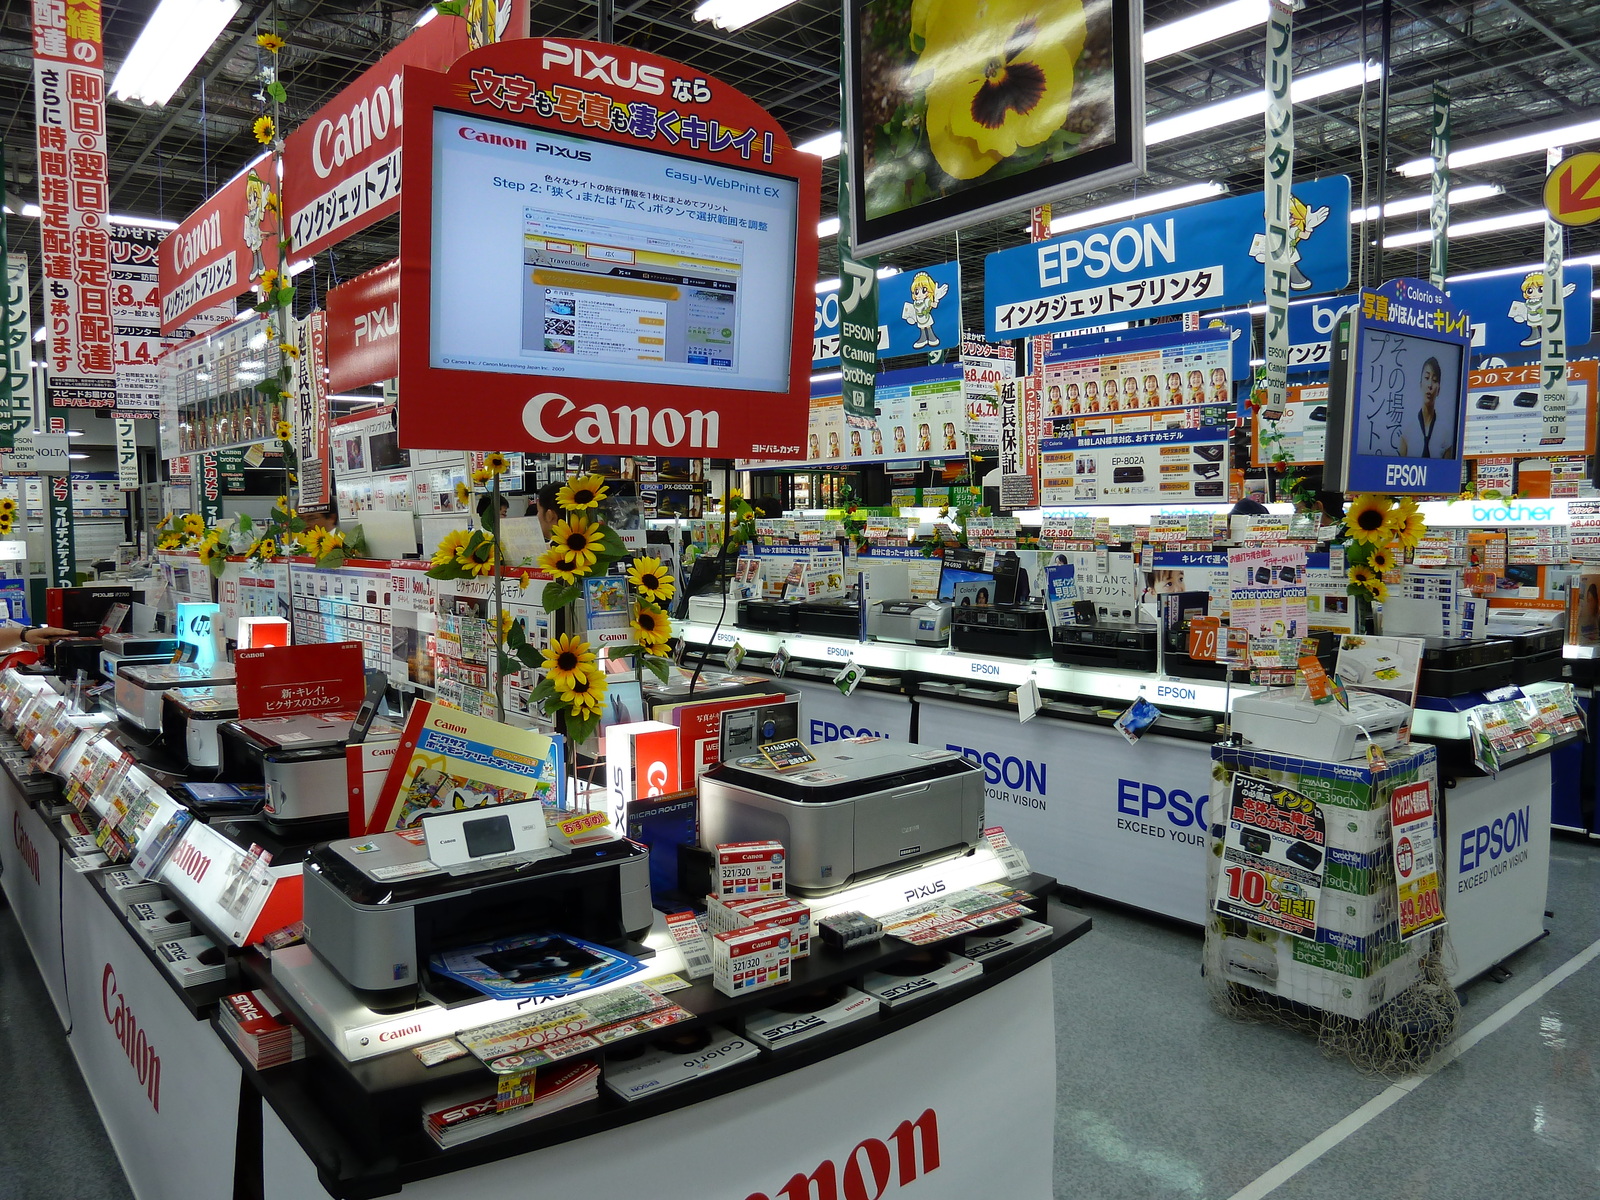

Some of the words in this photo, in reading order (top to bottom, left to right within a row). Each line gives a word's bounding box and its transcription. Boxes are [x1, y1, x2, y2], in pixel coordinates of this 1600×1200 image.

[542, 41, 664, 96] PIXUS
[672, 77, 711, 103] なら
[470, 67, 774, 165] 文字も写真も凄くキレイ！
[458, 127, 527, 150] Canon
[536, 143, 592, 162] PIXUS
[493, 177, 526, 192] Step
[530, 183, 542, 193] 2:
[665, 168, 761, 195] Easy-WebPrint
[764, 187, 780, 198] EX
[1268, 20, 1291, 340] プリンターフェア
[173, 209, 222, 275] Canon
[549, 257, 590, 268] TravelGuide
[1037, 218, 1176, 289] EPSON
[164, 257, 232, 321] インクジェットプリンタ
[1407, 286, 1433, 304] Colorio
[1000, 271, 1213, 330] インクジェットプリンタ
[354, 303, 399, 347] PIXU
[1361, 292, 1470, 338] 写真がほんとにキレイ！
[842, 322, 875, 342] EPSON
[842, 344, 875, 364] Canon
[963, 341, 1015, 359] プリンター設定
[1268, 346, 1287, 359] EPSON
[841, 366, 875, 386] brother
[1544, 394, 1565, 402] EPSON
[522, 392, 720, 448] Canon
[1001, 381, 1018, 475] 延長保証
[1025, 378, 1036, 469] 買った後も安心！
[752, 444, 800, 454] ヨドバシカメラ
[1111, 457, 1145, 466] EP-802A
[1385, 464, 1427, 487] EPSON
[1472, 504, 1555, 522] brother
[1044, 528, 1073, 537] ¥22,980
[1077, 573, 1132, 585] 無線LANで、
[1231, 588, 1256, 600] brother
[1257, 588, 1281, 599] brother
[1282, 586, 1306, 597] brother
[599, 633, 628, 643] Canon
[717, 633, 735, 642] EPSON
[240, 651, 265, 659] Canon
[827, 646, 850, 657] EPSON
[971, 662, 1000, 675] EPSON
[1157, 685, 1196, 700] EPSON
[265, 695, 340, 711] ピクサスのひみつ
[433, 718, 468, 735] Canon
[428, 732, 467, 750] ピクサス
[425, 741, 536, 775] ポケモンプリントギャラリー
[1333, 766, 1363, 779] brother
[1236, 778, 1273, 792] プリンター
[984, 787, 1010, 803] YOUR
[1012, 793, 1047, 811] VISION
[1272, 789, 1316, 814] インク
[629, 808, 657, 820] MICRO
[658, 800, 694, 815] ROUTER
[1242, 798, 1315, 828] 本体と一緒に
[562, 813, 606, 835] おすすめ！
[1117, 818, 1166, 840] EXCEED
[1168, 829, 1205, 848] YOUR
[13, 810, 40, 886] Canon
[439, 838, 457, 846] Canon
[1272, 834, 1295, 845] brother
[1459, 805, 1530, 874] EPSON
[172, 839, 212, 884] anon
[1332, 850, 1362, 864] brother
[722, 868, 751, 878] 321/320
[1458, 869, 1489, 893] EXCEED
[1489, 860, 1507, 878] YOUR
[1508, 849, 1529, 869] VISION
[904, 880, 946, 902] PIXUS
[137, 903, 160, 921] PIXUS
[1400, 888, 1441, 928] ¥9,280
[166, 942, 191, 961] PIXUS
[751, 940, 772, 949] Canon
[965, 938, 1006, 959] PIXUS
[733, 957, 761, 973] 321/320
[950, 962, 975, 975] Canon
[880, 977, 928, 1000] PIXUS
[231, 993, 264, 1021] PIXUS
[845, 997, 871, 1013] Canon
[378, 1022, 422, 1043] Canon
[766, 1014, 826, 1039] PIXUS
[102, 963, 161, 1115] Canon
[683, 1040, 745, 1070] Colorio
[554, 1063, 588, 1087] Canon
[630, 1079, 660, 1093] EPSON
